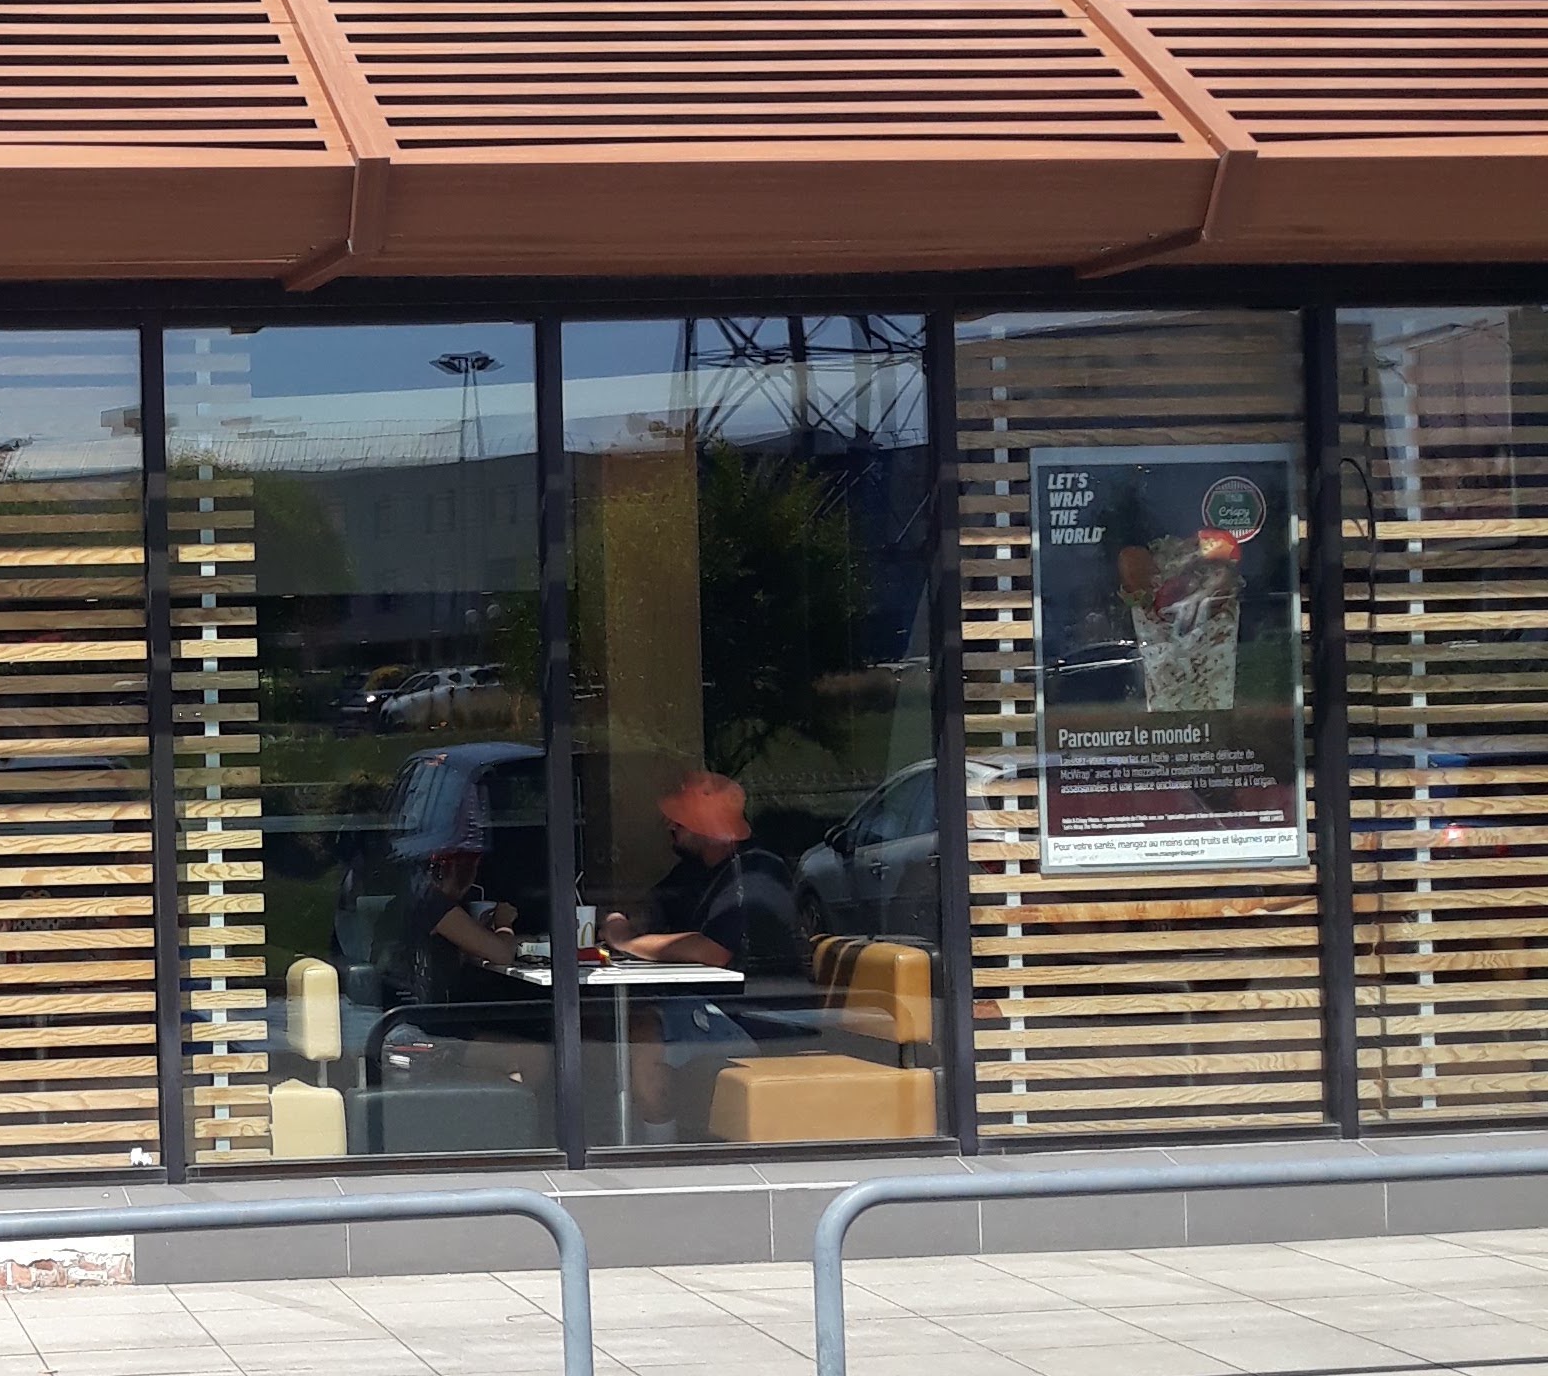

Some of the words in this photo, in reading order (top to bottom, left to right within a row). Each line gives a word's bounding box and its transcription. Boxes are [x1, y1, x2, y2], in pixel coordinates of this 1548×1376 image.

[1047, 472, 1089, 490] LET'S
[1049, 491, 1094, 508] WRAP
[1050, 509, 1079, 526] THE
[1058, 728, 1132, 748] Parcourez
[1133, 725, 1149, 745] le
[1151, 724, 1201, 744] monde
